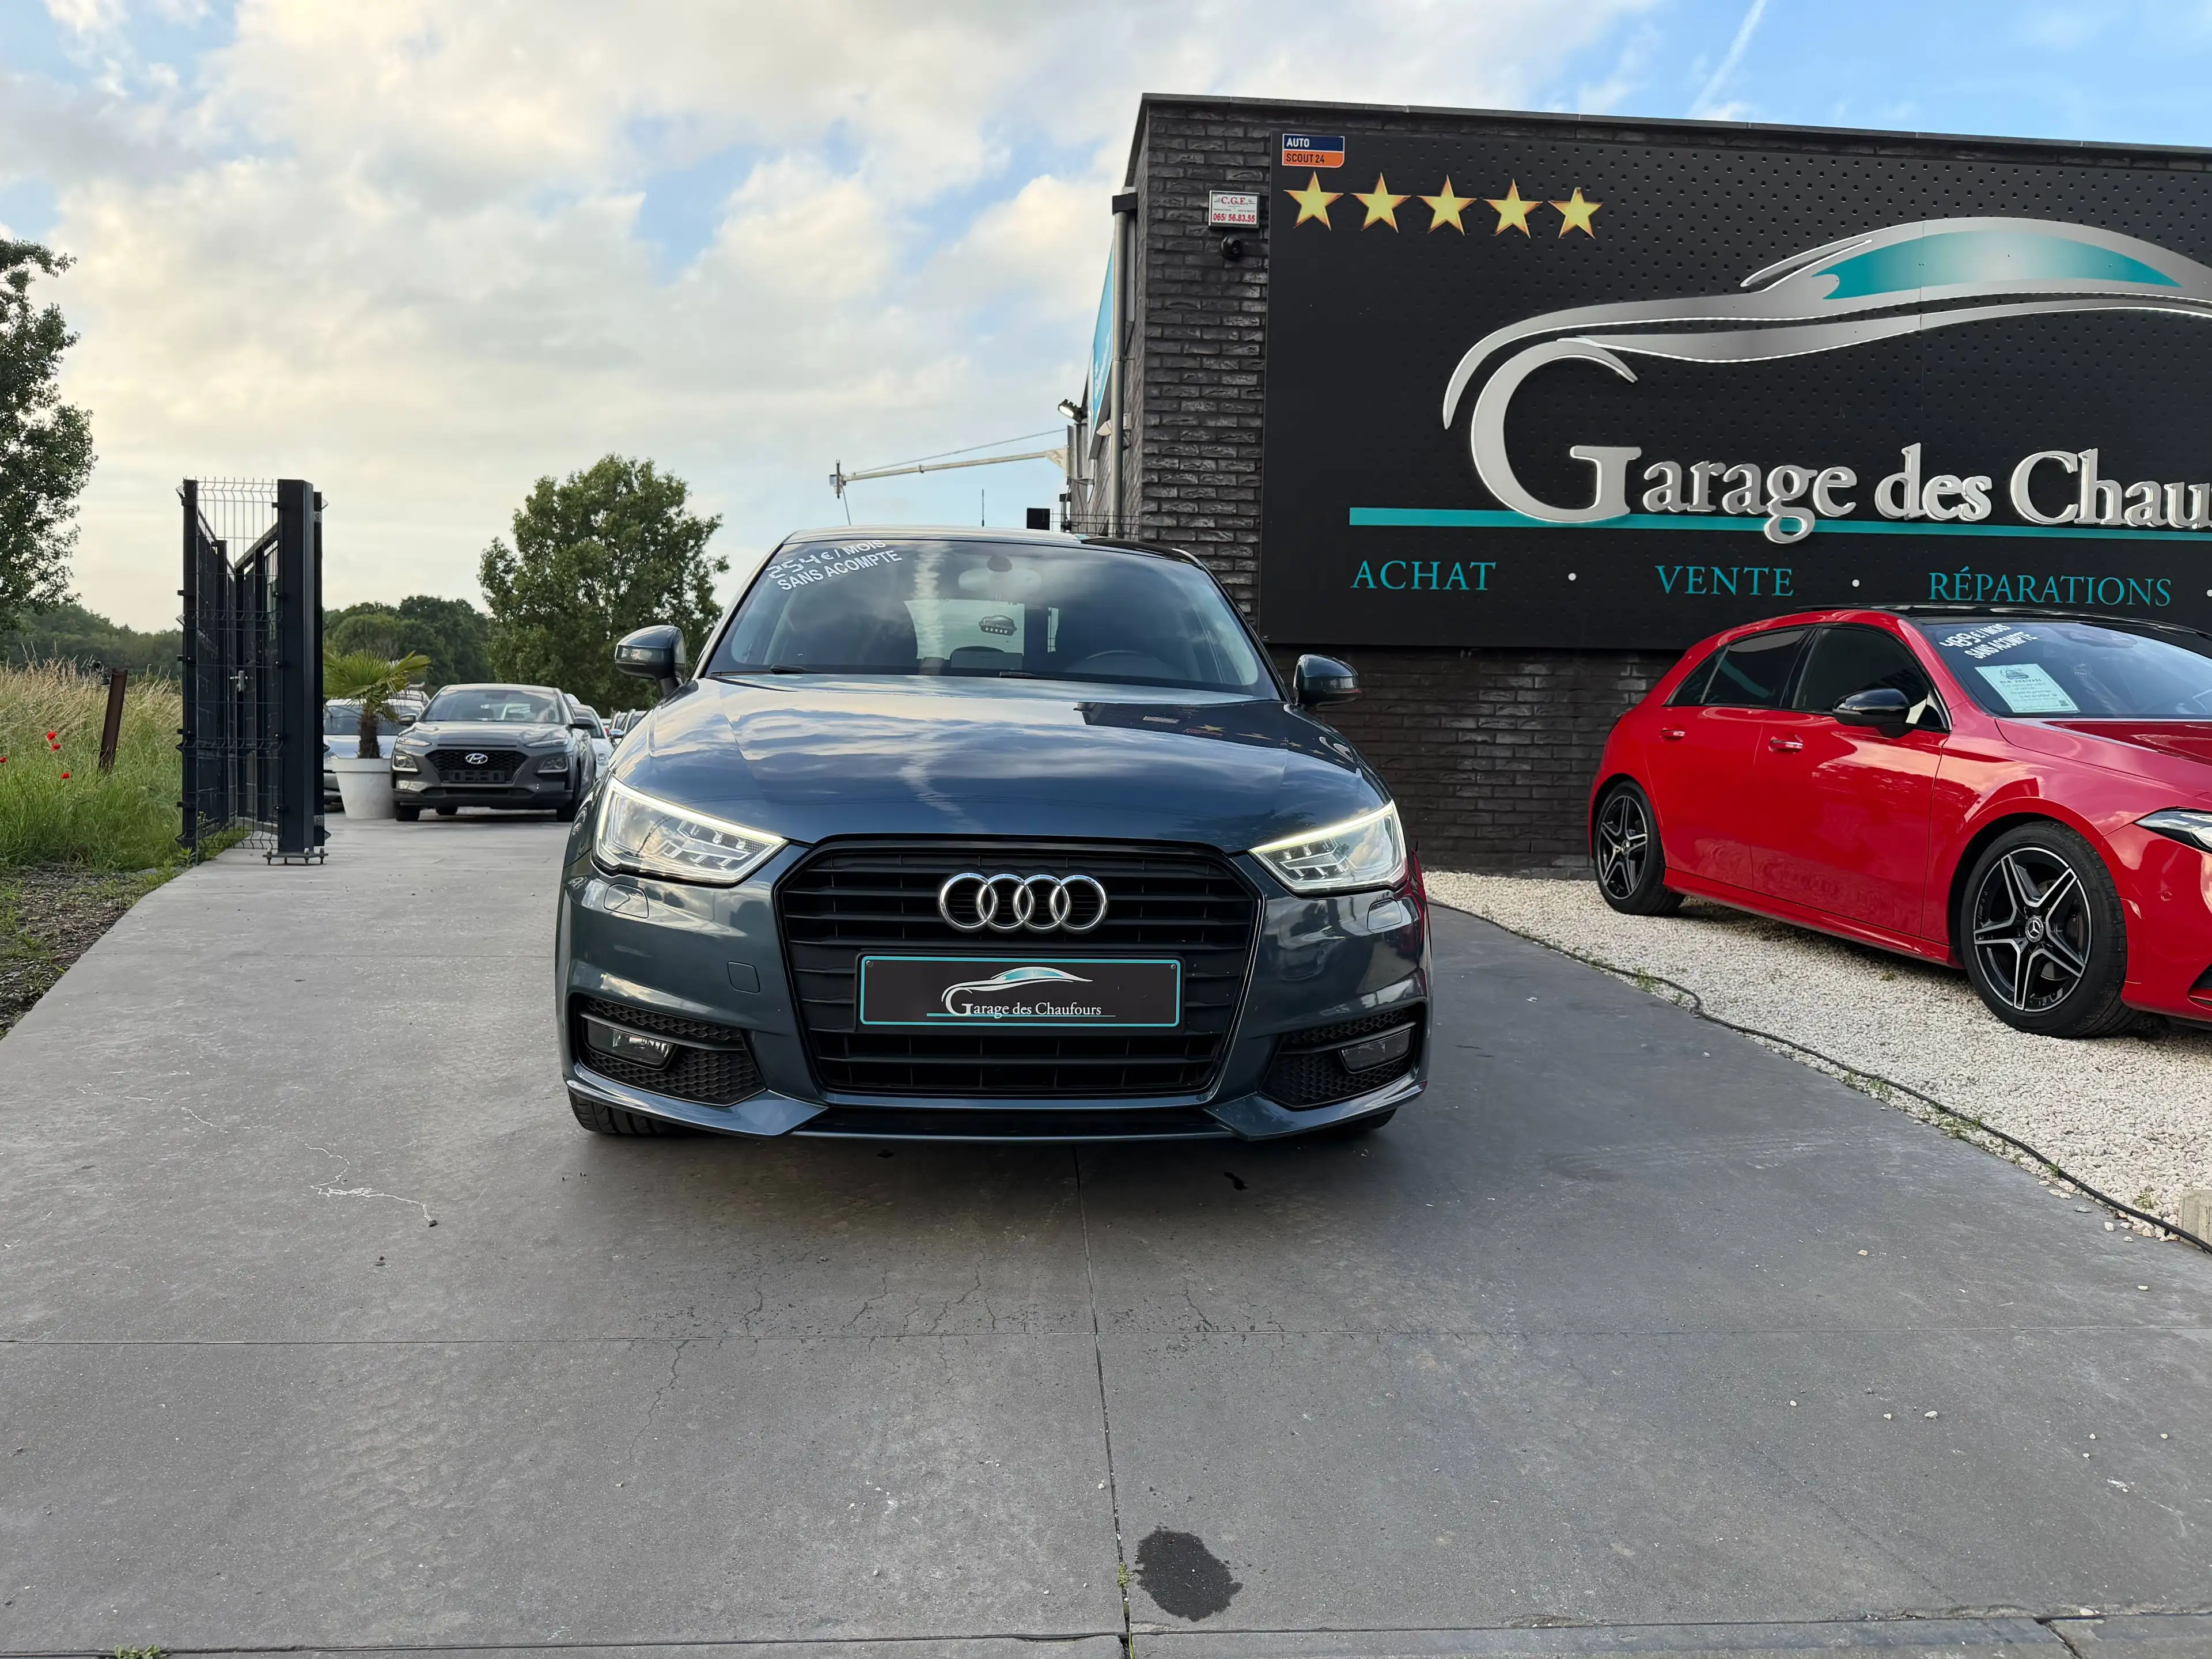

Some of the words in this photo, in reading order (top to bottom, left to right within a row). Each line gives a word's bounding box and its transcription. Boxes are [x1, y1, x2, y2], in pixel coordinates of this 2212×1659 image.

[1286, 138, 1310, 147] AUTO
[1286, 153, 1314, 163] SCOUT
[1315, 154, 1325, 164] 24
[1221, 196, 1248, 205] C.G.E.
[1471, 337, 1858, 544] Garage
[1874, 442, 1992, 521] des
[2010, 448, 2212, 529] Chau
[843, 540, 887, 555] MOIS
[777, 569, 824, 590] SANS
[824, 550, 903, 578] ACOMPTE
[1350, 560, 1497, 590] ACHAT
[1655, 565, 1794, 597] VENTE
[1927, 566, 2172, 607] RÉPARATIONS
[1980, 623, 2012, 635] MOIS
[1964, 644, 1999, 659] SANS
[1988, 631, 2038, 651] ACOMPTE
[945, 987, 1009, 1019] Garage
[1012, 1003, 1032, 1015] des
[1035, 1002, 1101, 1015] Chaufours
